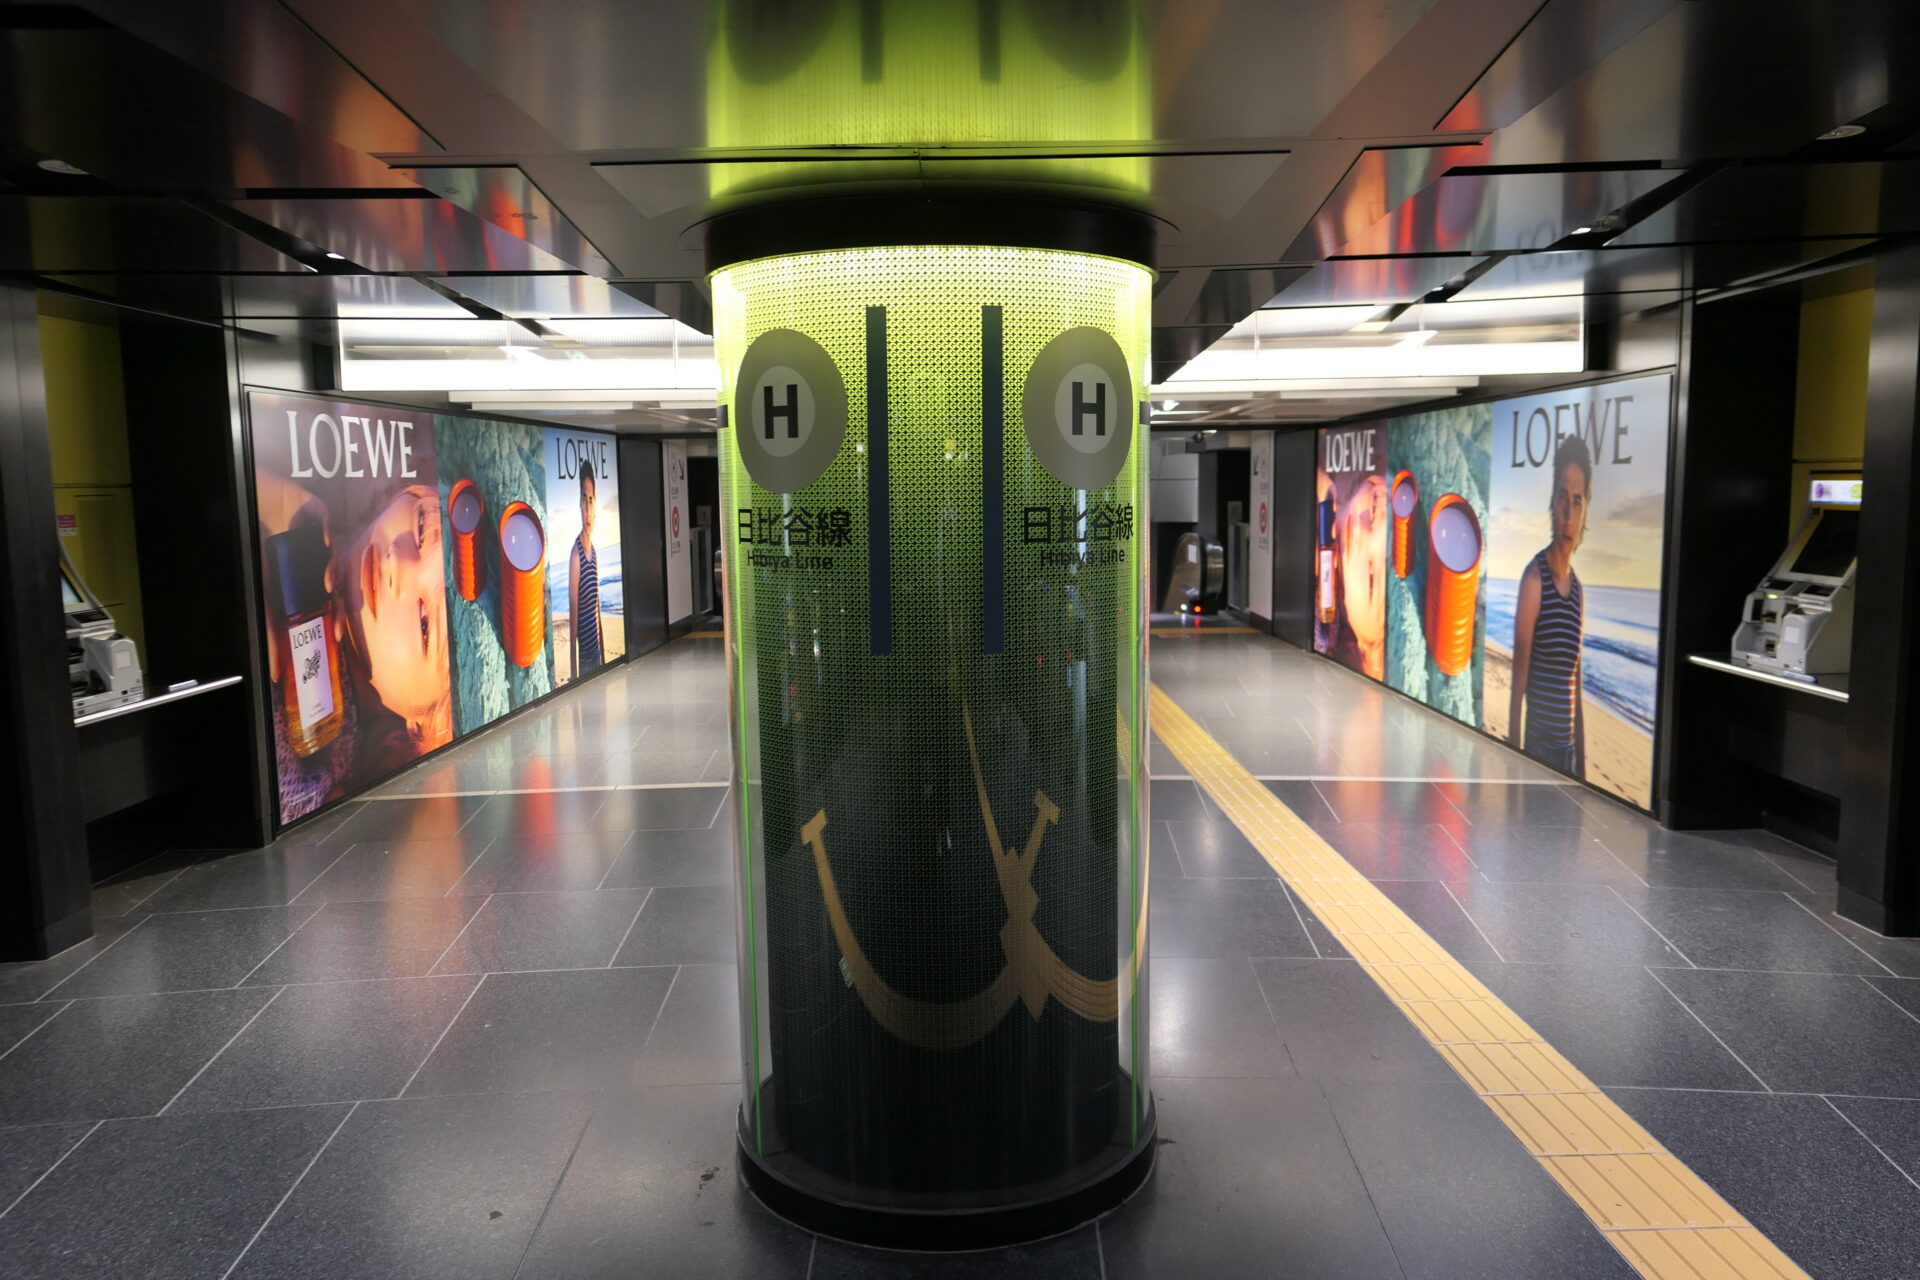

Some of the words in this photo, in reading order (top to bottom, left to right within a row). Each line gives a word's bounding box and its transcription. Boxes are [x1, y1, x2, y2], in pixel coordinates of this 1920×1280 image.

[763, 383, 799, 440] H
[1071, 381, 1106, 437] H
[286, 410, 417, 478] LOEWE
[1325, 429, 1376, 473] LOEWE
[1511, 395, 1634, 468] LOEWE
[556, 437, 608, 480] LOEWE
[738, 507, 853, 547] 日比谷線
[1023, 502, 1134, 544] 日比谷線
[796, 550, 833, 569] Line
[1101, 547, 1126, 563] Line
[292, 624, 322, 649] LOEWE
